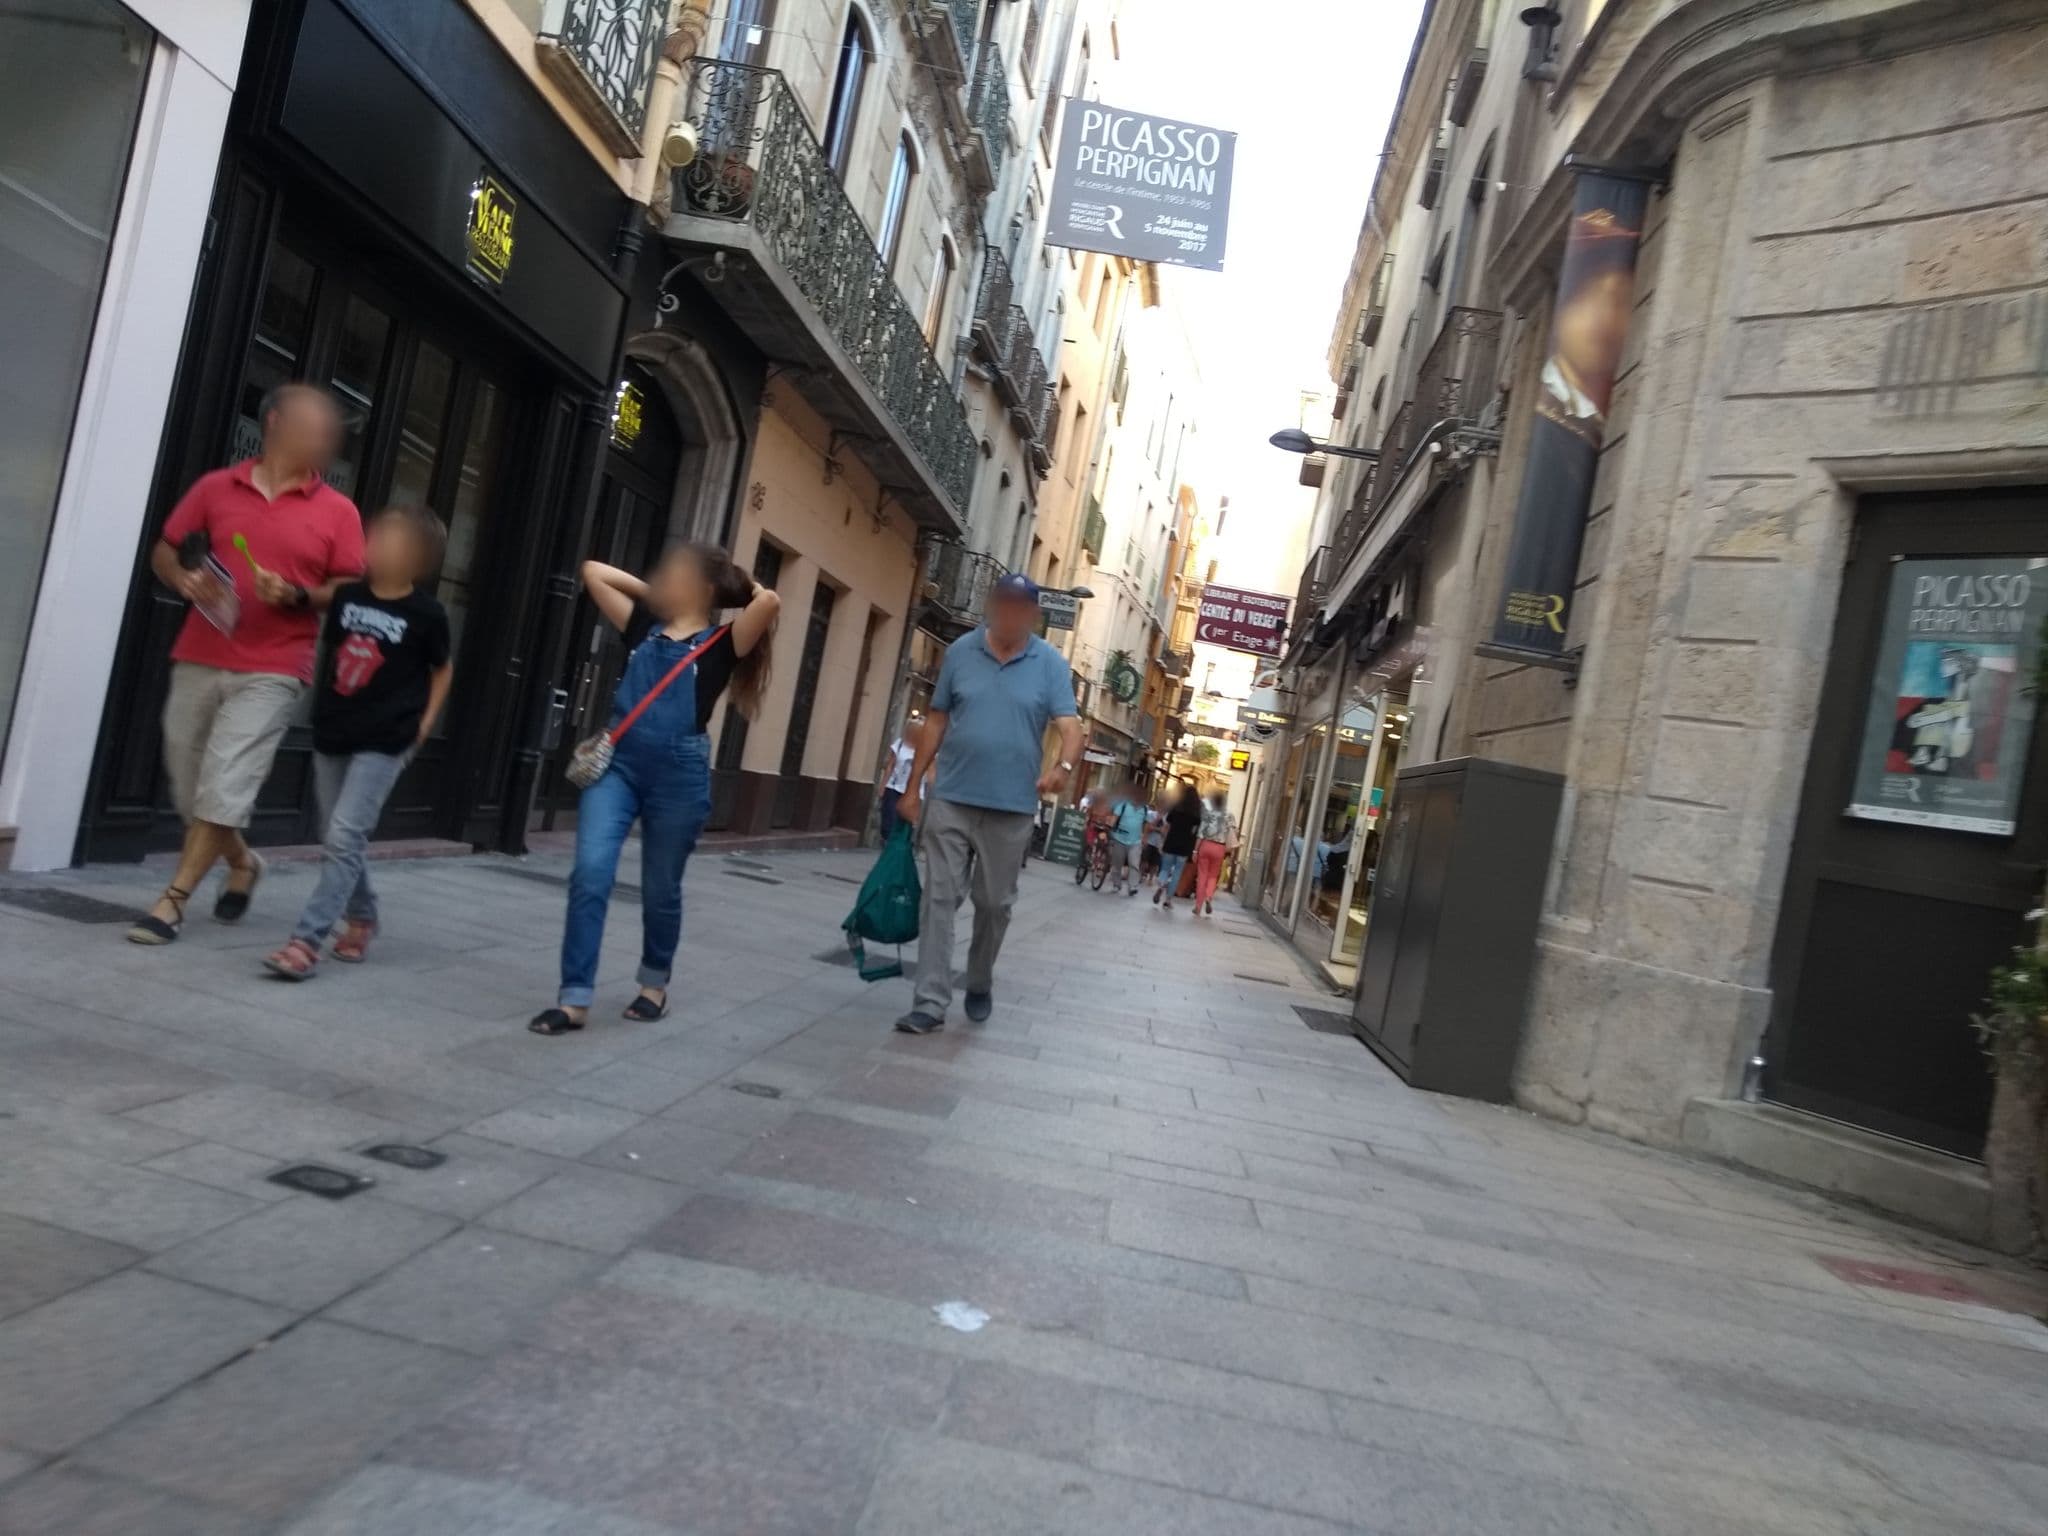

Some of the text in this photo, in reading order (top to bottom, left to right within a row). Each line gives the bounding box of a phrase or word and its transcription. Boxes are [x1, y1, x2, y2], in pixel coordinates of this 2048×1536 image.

[1080, 109, 1221, 166] PICASSO
[1076, 145, 1216, 195] PERPIGNAN
[1144, 222, 1208, 241] 5 novembre
[1157, 214, 1209, 232] 24 juin au
[1178, 239, 1207, 252] 2017
[1911, 574, 2031, 607] PICASSO
[1200, 602, 1232, 620] CENTRE
[1233, 609, 1247, 622] DU
[1232, 631, 1263, 648] Etage
